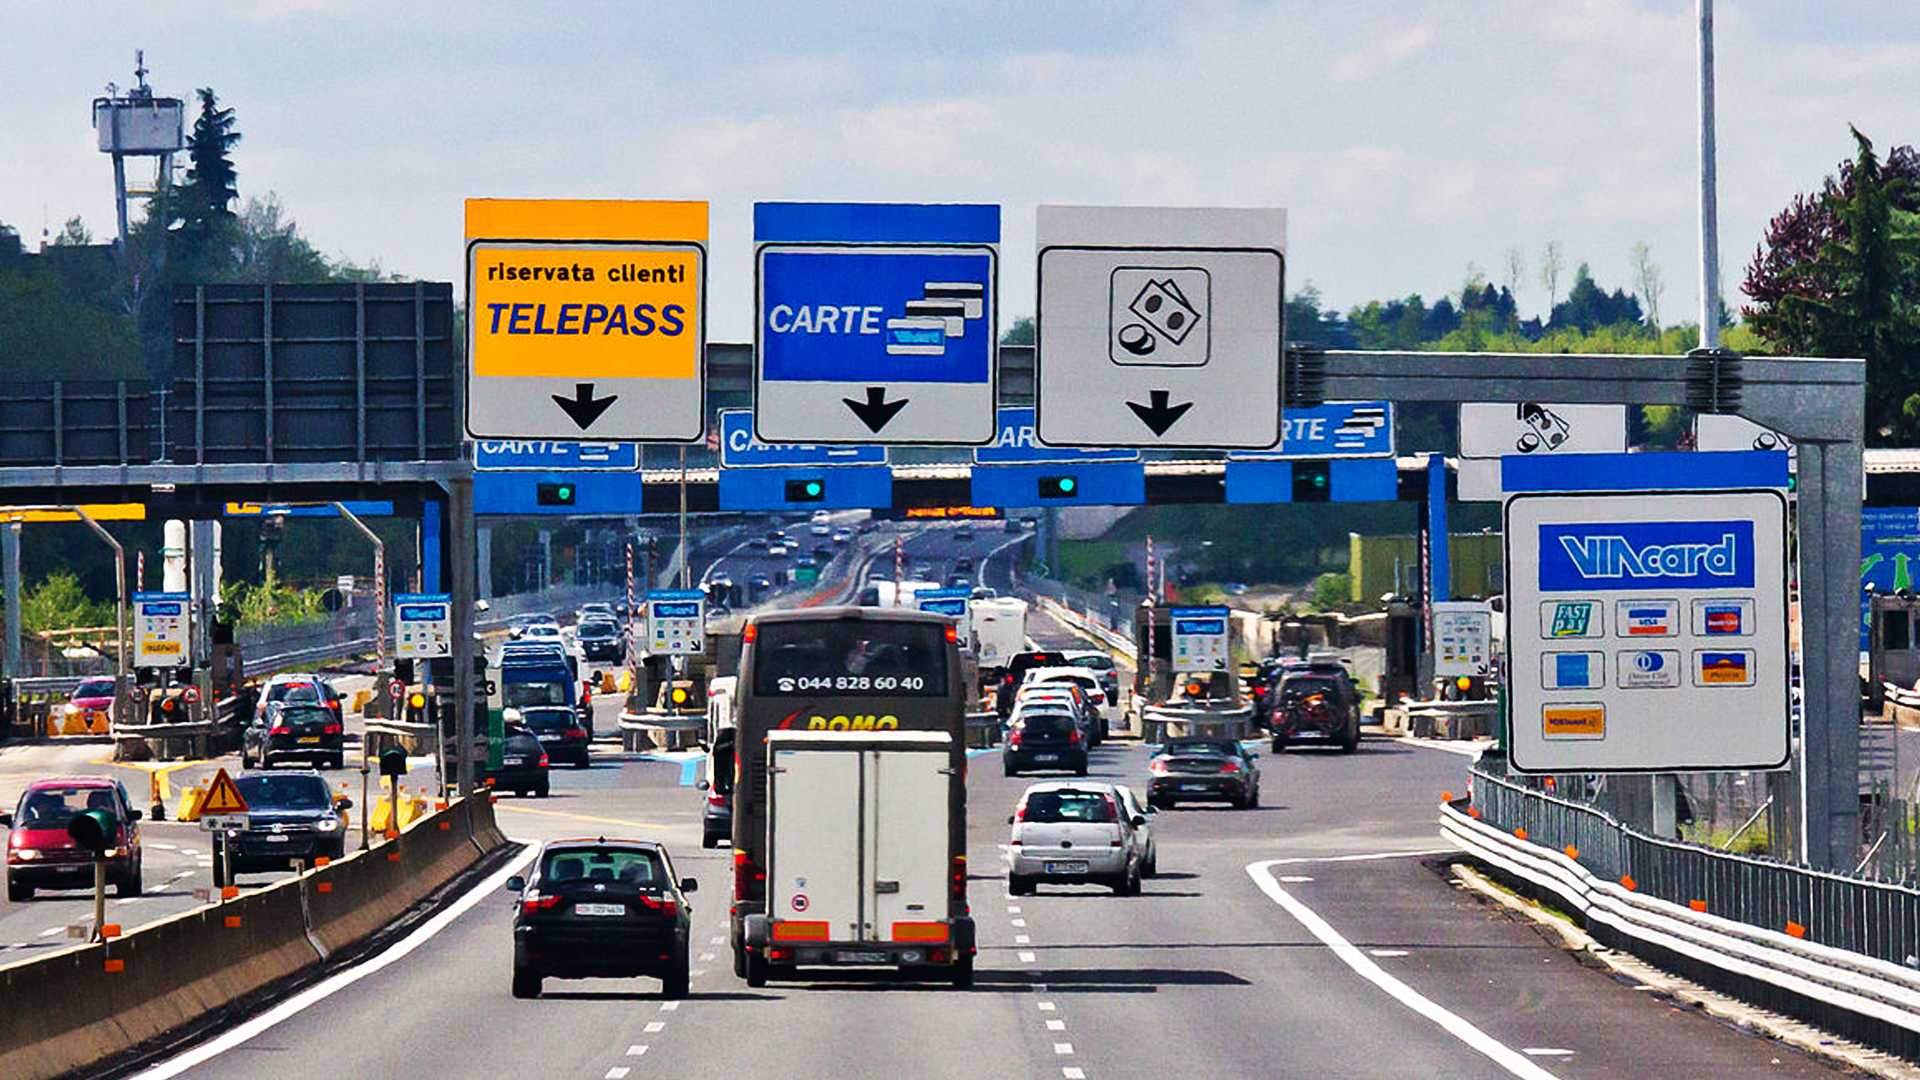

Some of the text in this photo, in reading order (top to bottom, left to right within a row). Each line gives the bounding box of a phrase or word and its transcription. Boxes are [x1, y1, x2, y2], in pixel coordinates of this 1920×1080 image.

[488, 263, 685, 283] riservata clienti
[487, 302, 685, 336] TELEPASS
[769, 305, 883, 335] CARTE
[1557, 605, 1589, 618] FAST
[797, 676, 924, 690] 044 828 60 40
